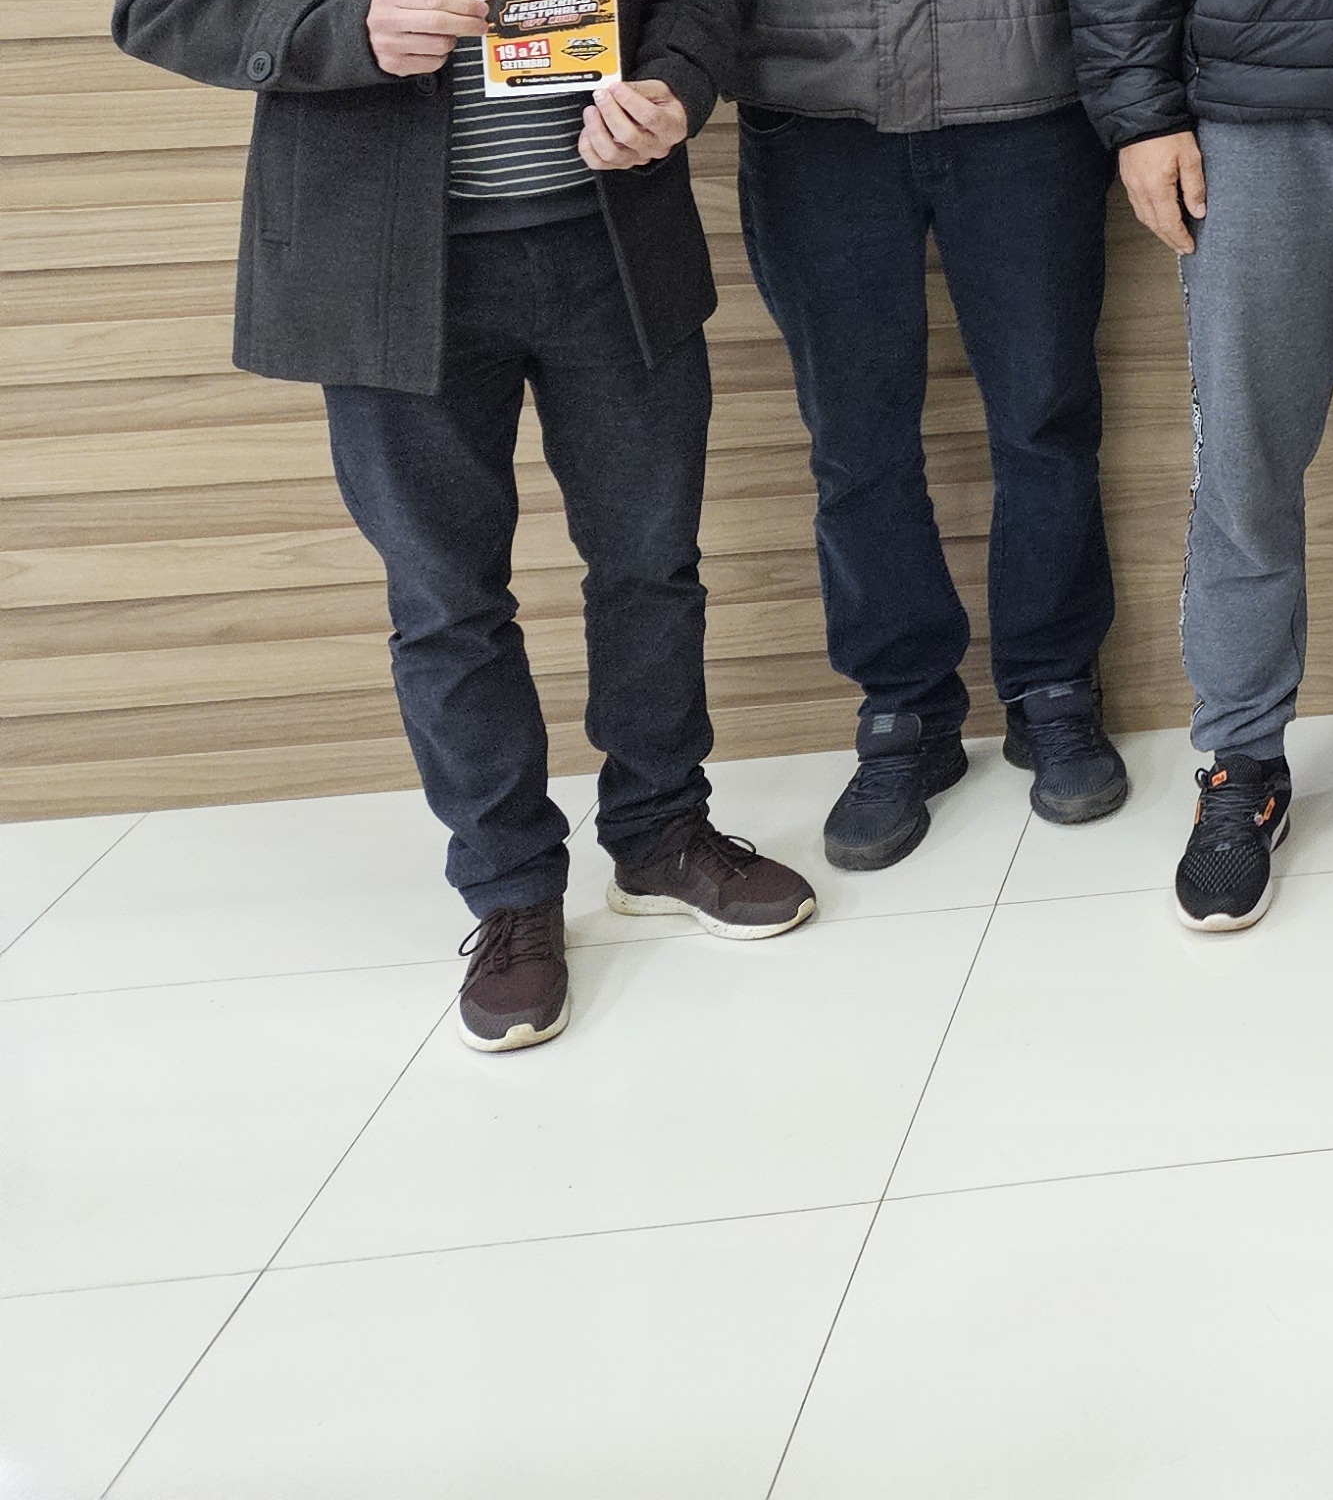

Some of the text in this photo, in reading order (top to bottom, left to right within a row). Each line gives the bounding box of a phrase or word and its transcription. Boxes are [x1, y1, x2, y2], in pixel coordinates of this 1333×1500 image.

[503, 3, 597, 22] WESTPHALEN
[496, 44, 517, 60] 19
[518, 47, 528, 57] a
[528, 40, 549, 56] 21
